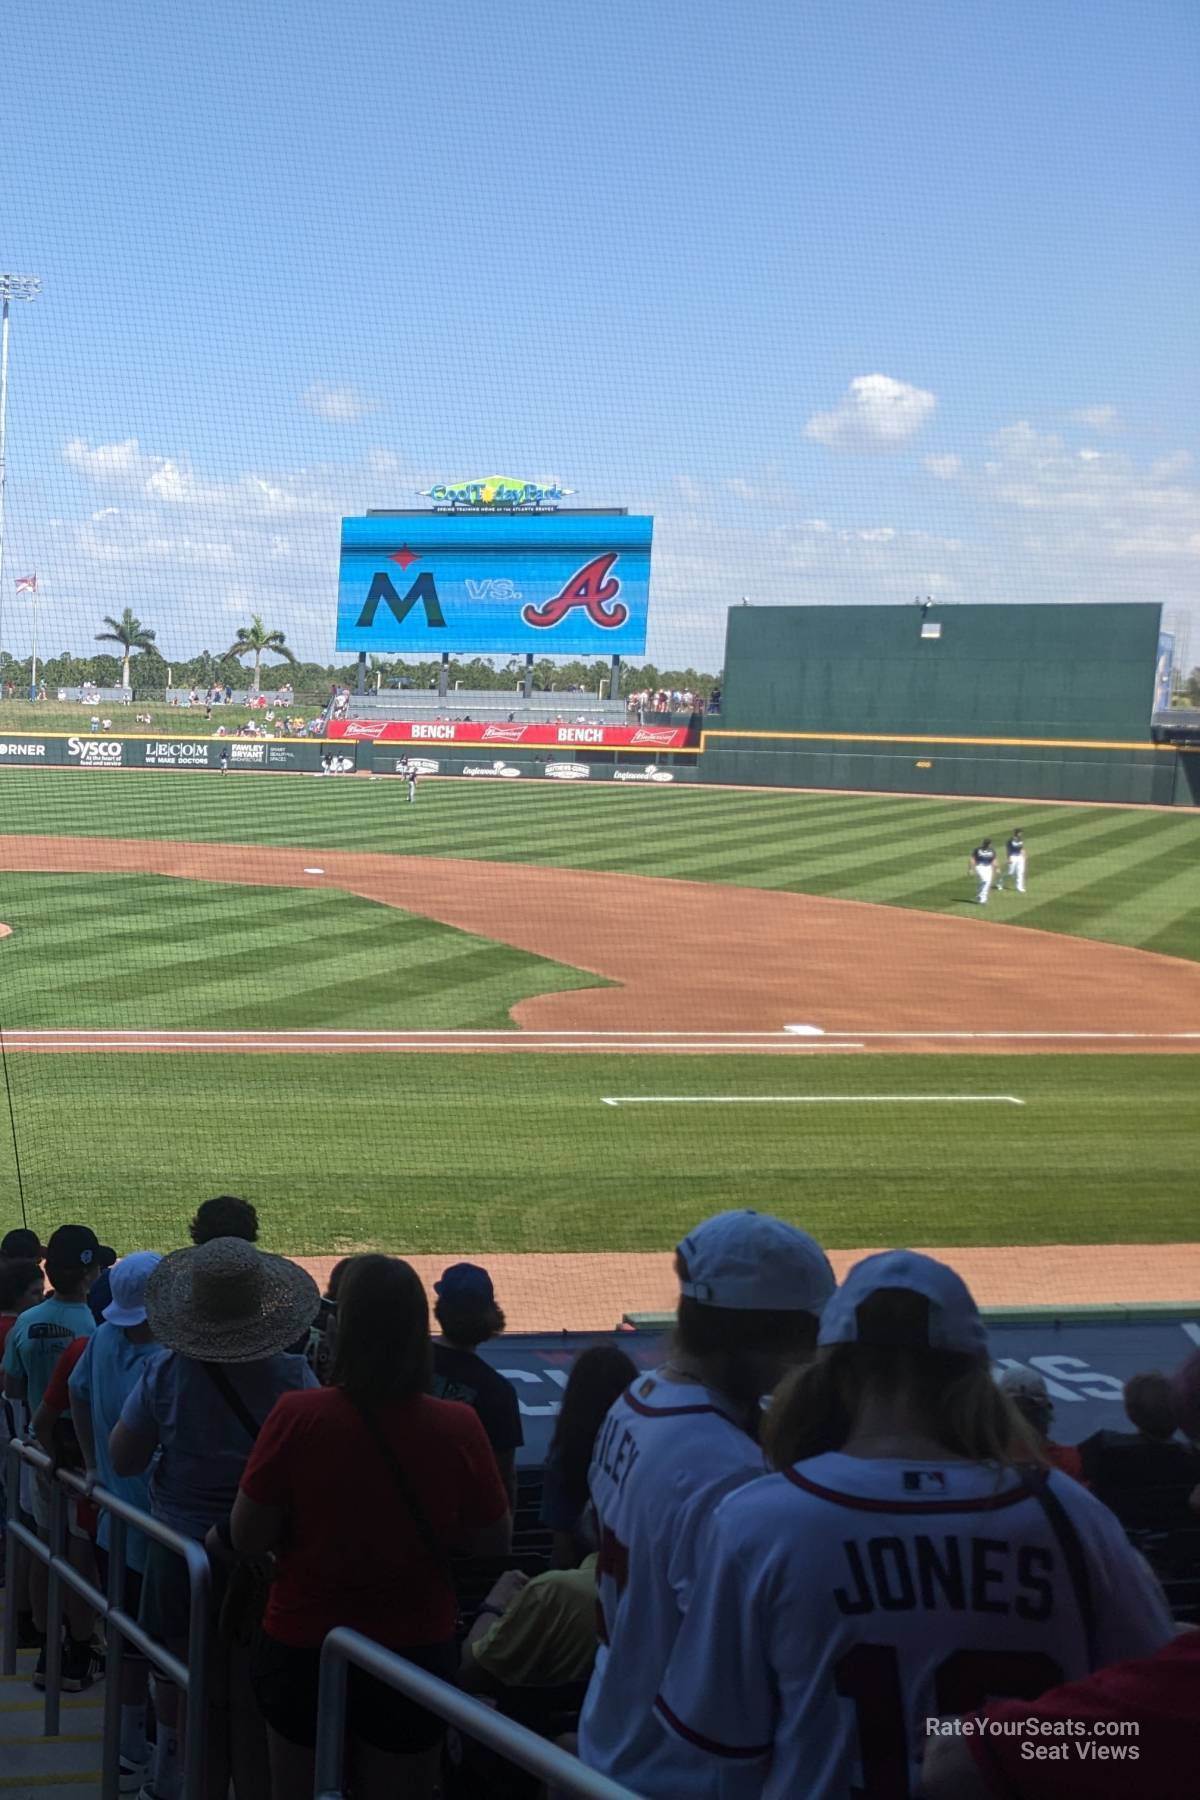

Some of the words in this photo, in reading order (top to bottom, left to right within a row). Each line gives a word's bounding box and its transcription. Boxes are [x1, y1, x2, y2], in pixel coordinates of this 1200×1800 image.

[355, 572, 447, 627] M
[521, 552, 628, 629] A
[411, 724, 455, 738] BENCH
[558, 728, 603, 742] BENCH
[462, 766, 497, 776] Englewood
[613, 770, 649, 781] Englewood
[594, 1416, 639, 1494] ILEY
[832, 1535, 1057, 1621] JONES
